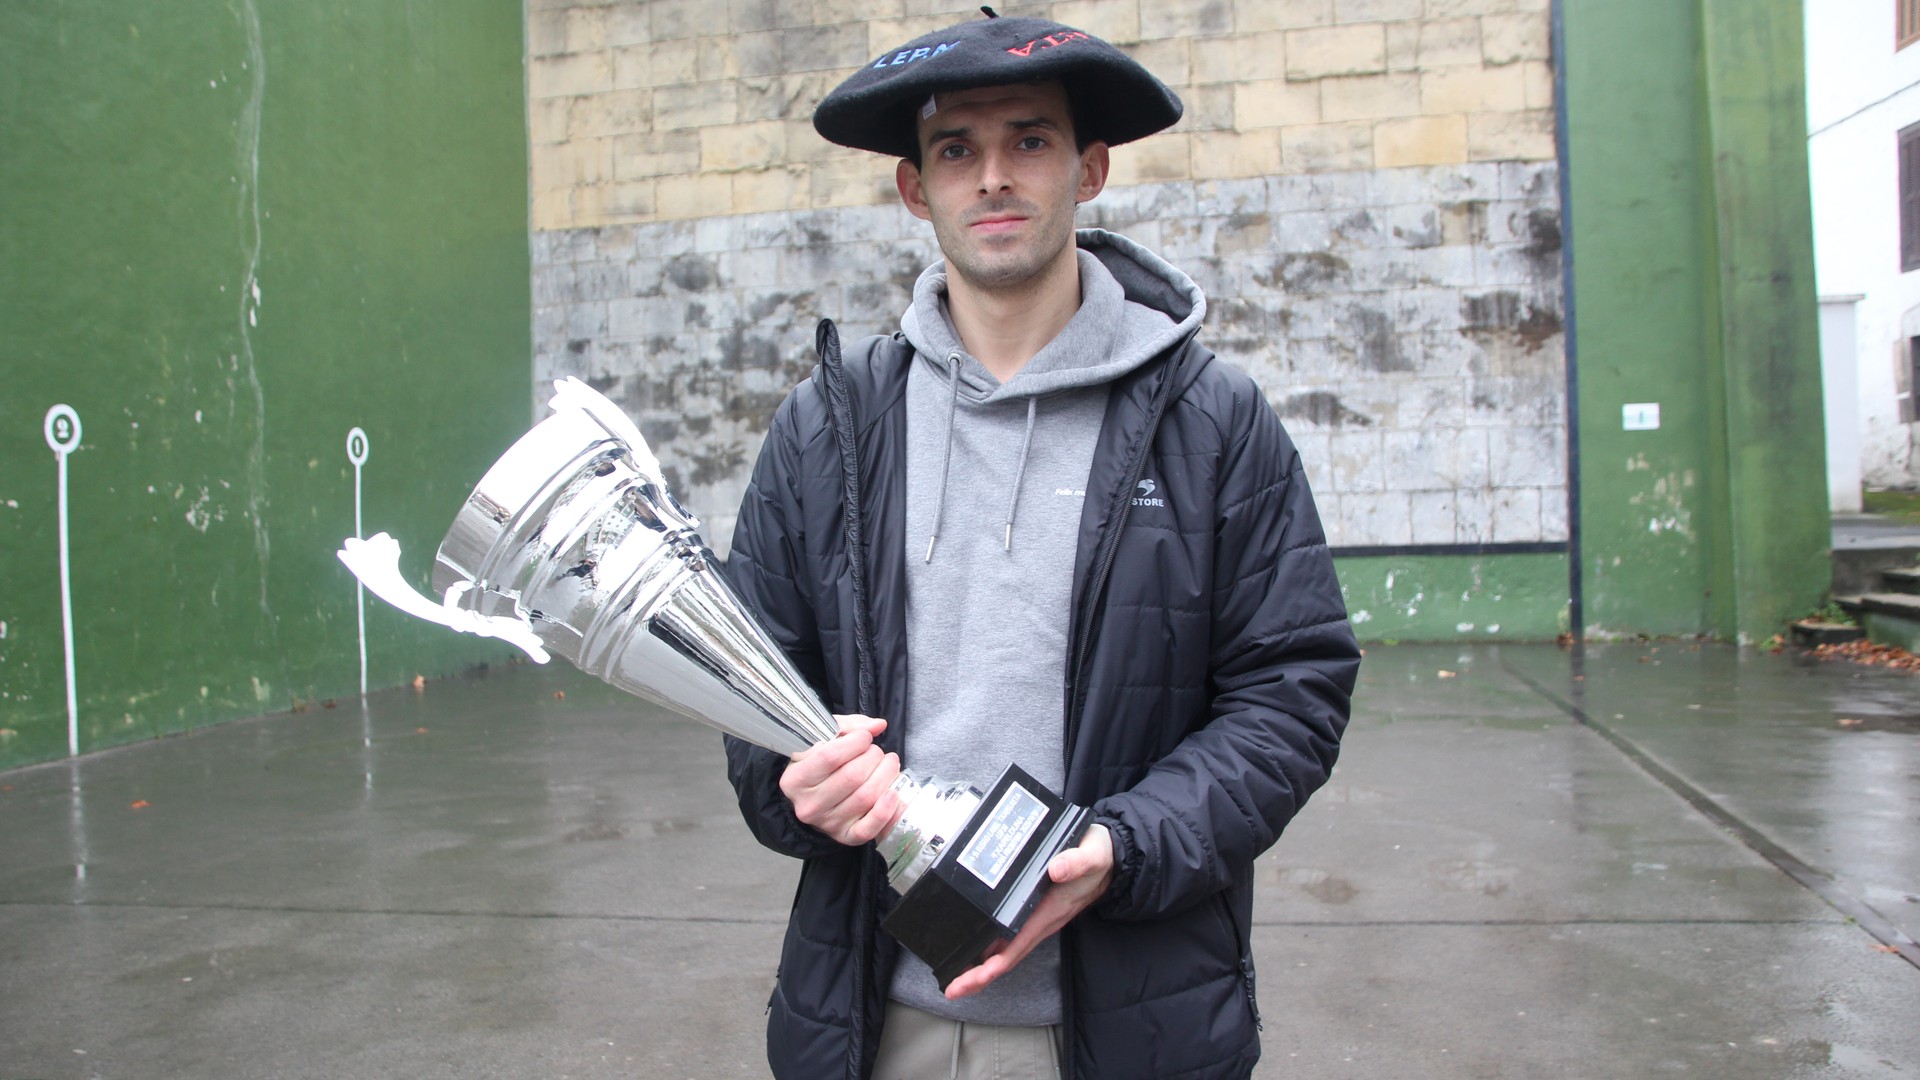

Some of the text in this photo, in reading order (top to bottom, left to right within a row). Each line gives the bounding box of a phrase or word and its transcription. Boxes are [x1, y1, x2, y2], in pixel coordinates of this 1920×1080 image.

[56, 418, 69, 438] 2
[1131, 497, 1165, 507] STORE
[991, 814, 1025, 858] TXAPELDUNA
